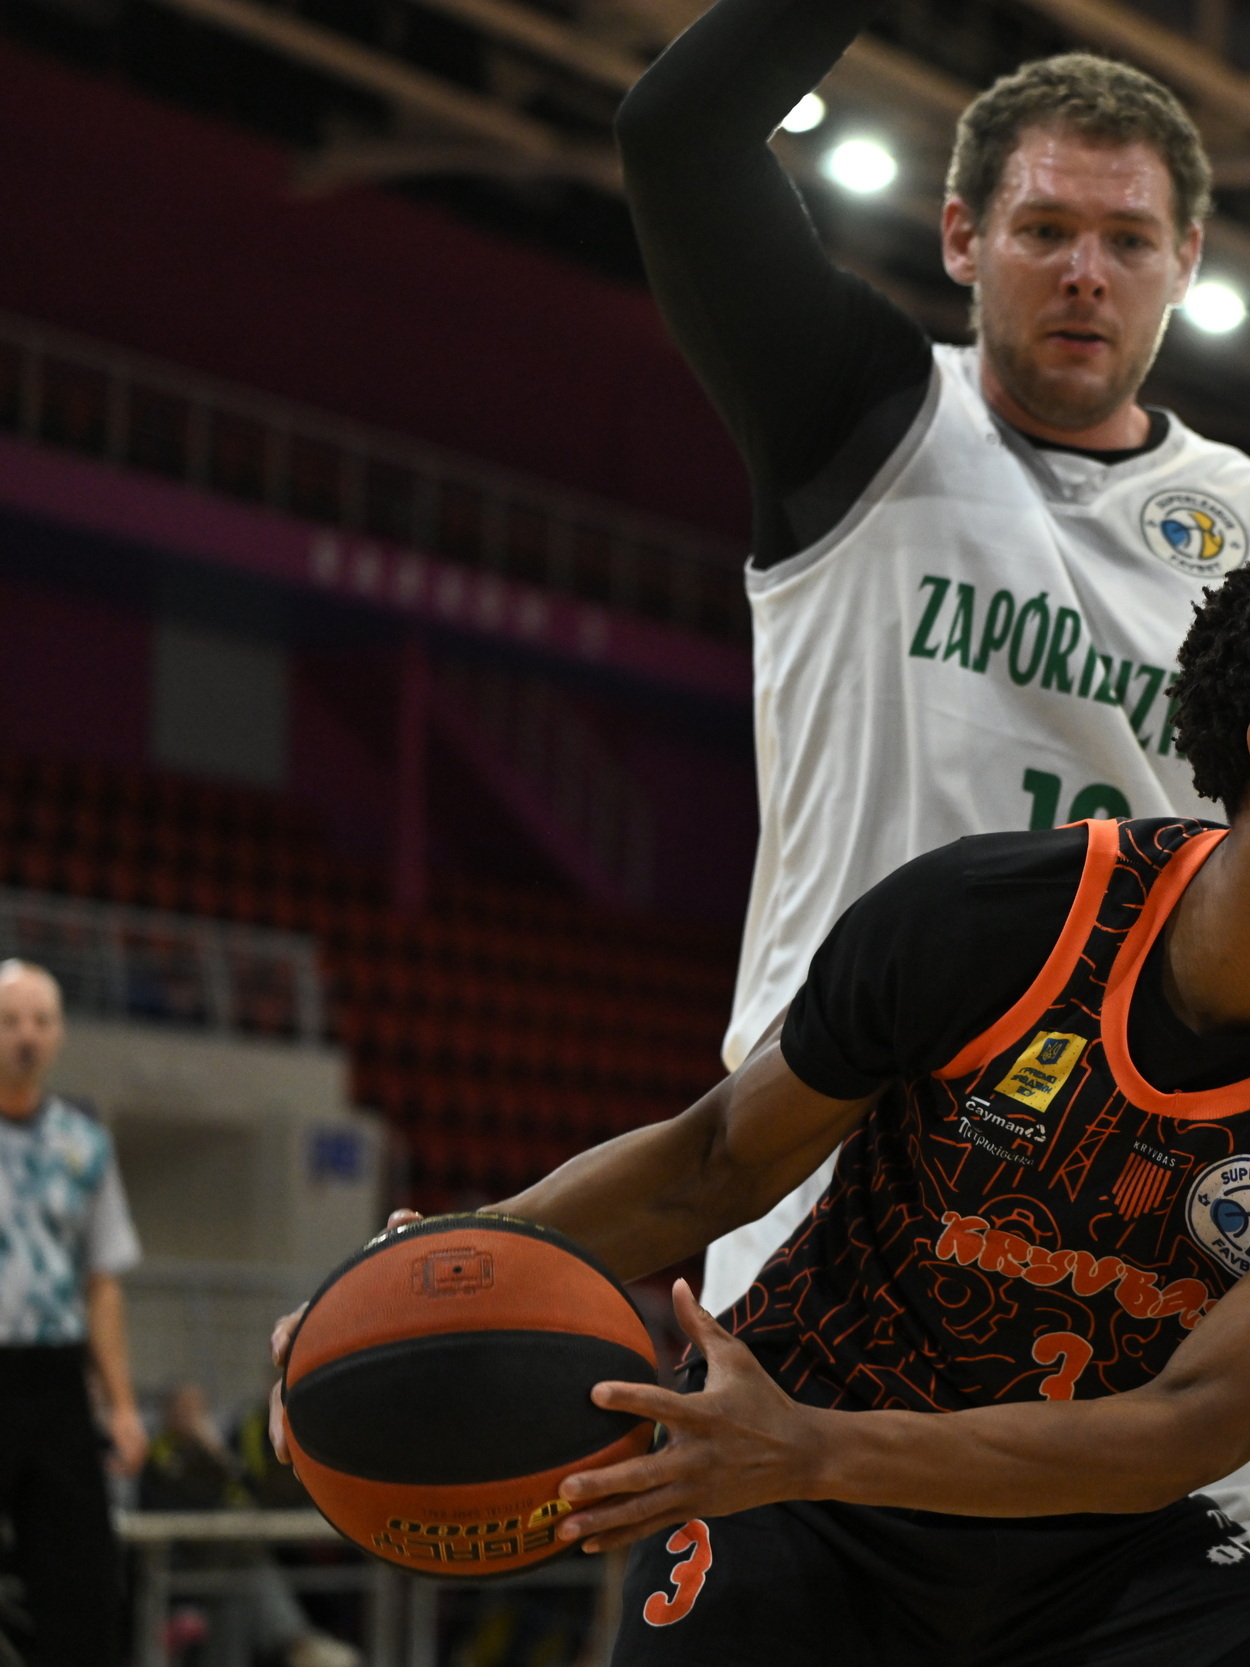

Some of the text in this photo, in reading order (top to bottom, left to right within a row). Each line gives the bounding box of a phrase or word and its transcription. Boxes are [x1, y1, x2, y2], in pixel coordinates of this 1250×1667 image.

[965, 1100, 1027, 1136] cayman
[1133, 1140, 1178, 1168] KRYVBAS
[371, 1523, 556, 1563] EGACY
[387, 1514, 521, 1538] 1000
[643, 1518, 712, 1627] 3
